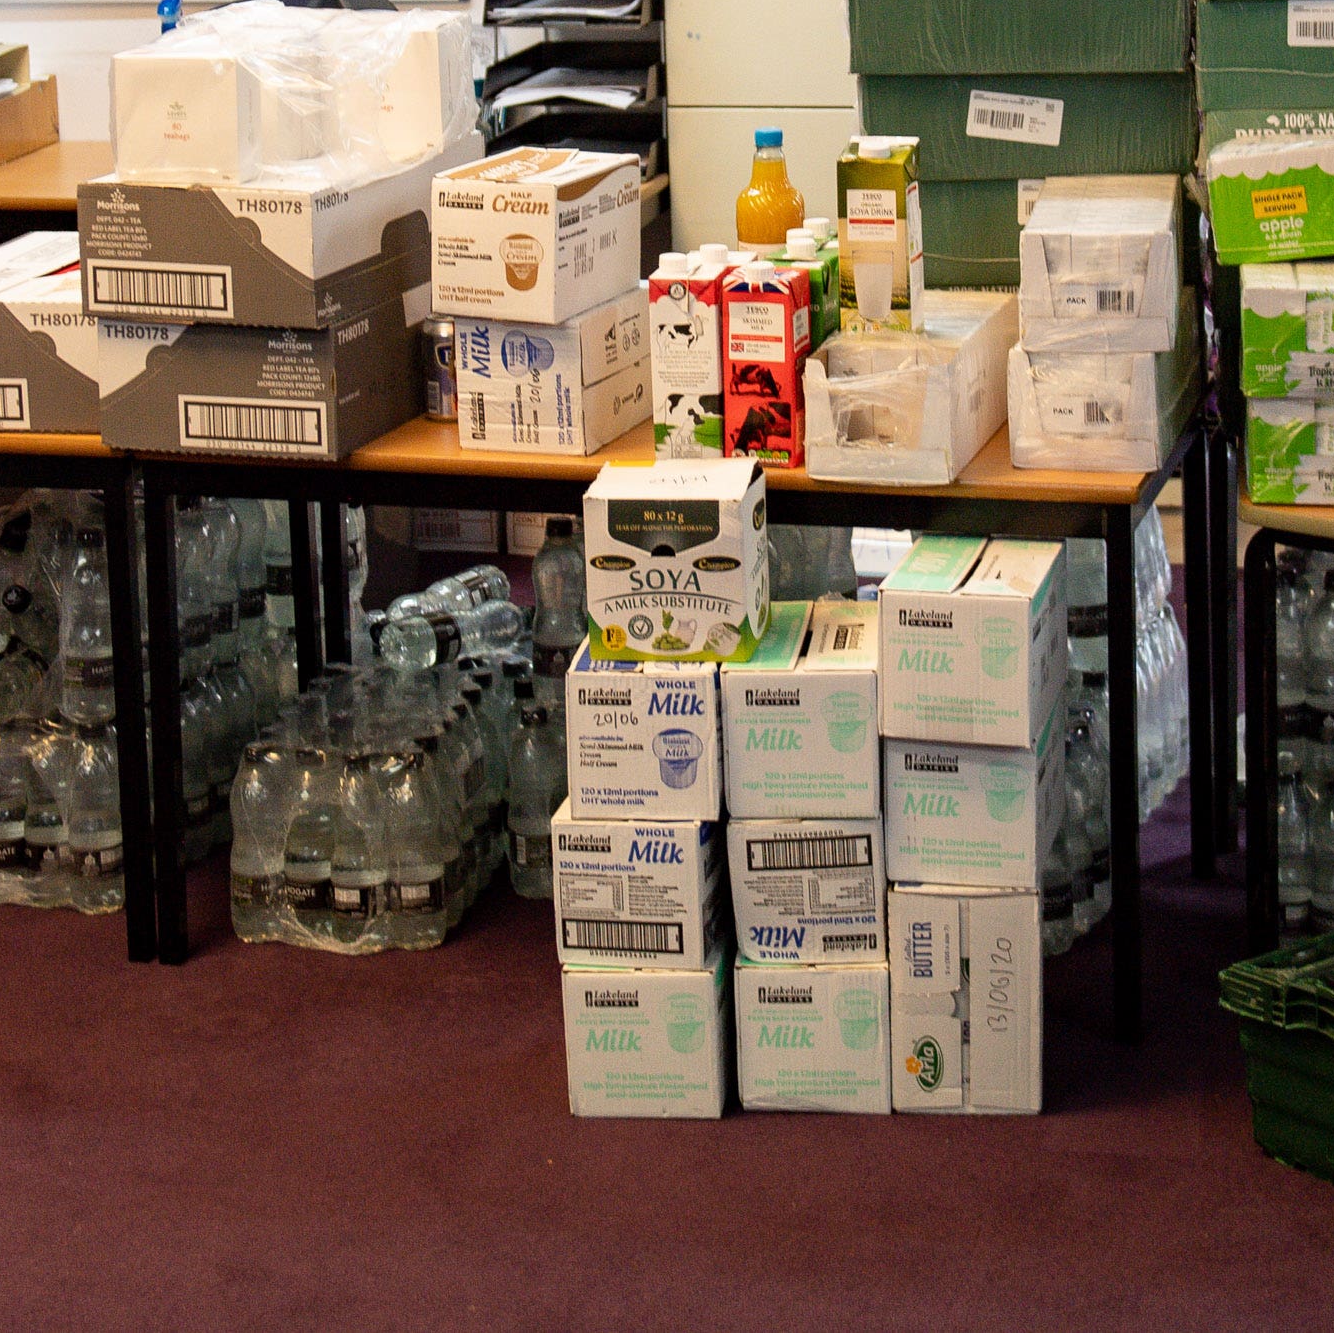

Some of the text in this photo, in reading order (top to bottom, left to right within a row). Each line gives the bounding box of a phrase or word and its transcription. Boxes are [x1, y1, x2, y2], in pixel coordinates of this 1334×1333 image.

[1284, 114, 1315, 128] 100%
[446, 191, 484, 202] Lakeland
[617, 188, 639, 208] Cream
[1254, 191, 1304, 204] SINGLE PACK
[97, 201, 140, 211] Morrisons
[237, 198, 303, 214] TH80178
[492, 195, 550, 215] Cream
[871, 208, 894, 216] DRINK
[1263, 203, 1297, 214] SERVING
[1259, 217, 1304, 234] apple
[30, 313, 97, 327] TH80178
[103, 324, 170, 340] TH80178
[337, 318, 369, 345] TH80178
[268, 340, 312, 351] Morrisons
[460, 326, 491, 378] WHOLE Milk
[644, 512, 655, 521] 80
[667, 511, 676, 521] 12
[678, 513, 684, 524] g
[629, 569, 701, 592] SOYA
[604, 595, 732, 615] A MILK SUBSTITUTE
[909, 609, 953, 620] Lakeland
[898, 648, 955, 674] Milk
[655, 681, 696, 689] WHOLE
[755, 688, 800, 698] Lakeland
[588, 688, 705, 716] Lakeland Milk
[594, 711, 639, 729] 20/06
[745, 727, 803, 751] Milk
[665, 749, 689, 757] Milk
[914, 753, 958, 764] Lakeland
[623, 789, 658, 797] portions
[903, 792, 960, 818] Milk
[635, 828, 675, 838] WHOLE
[568, 834, 684, 864] Lakeland Milk
[560, 861, 574, 869] 120
[601, 863, 636, 872] portions
[750, 926, 867, 952] Lakeland Milk
[760, 951, 799, 959] WHOLE
[913, 922, 933, 978] BUTTER
[768, 986, 812, 994] Lakeland
[987, 937, 1015, 1032] 13/06/20
[594, 990, 638, 999] Lakeland
[586, 1029, 641, 1052] Milk
[757, 1025, 815, 1048] Milk
[920, 1046, 935, 1084] Arla
